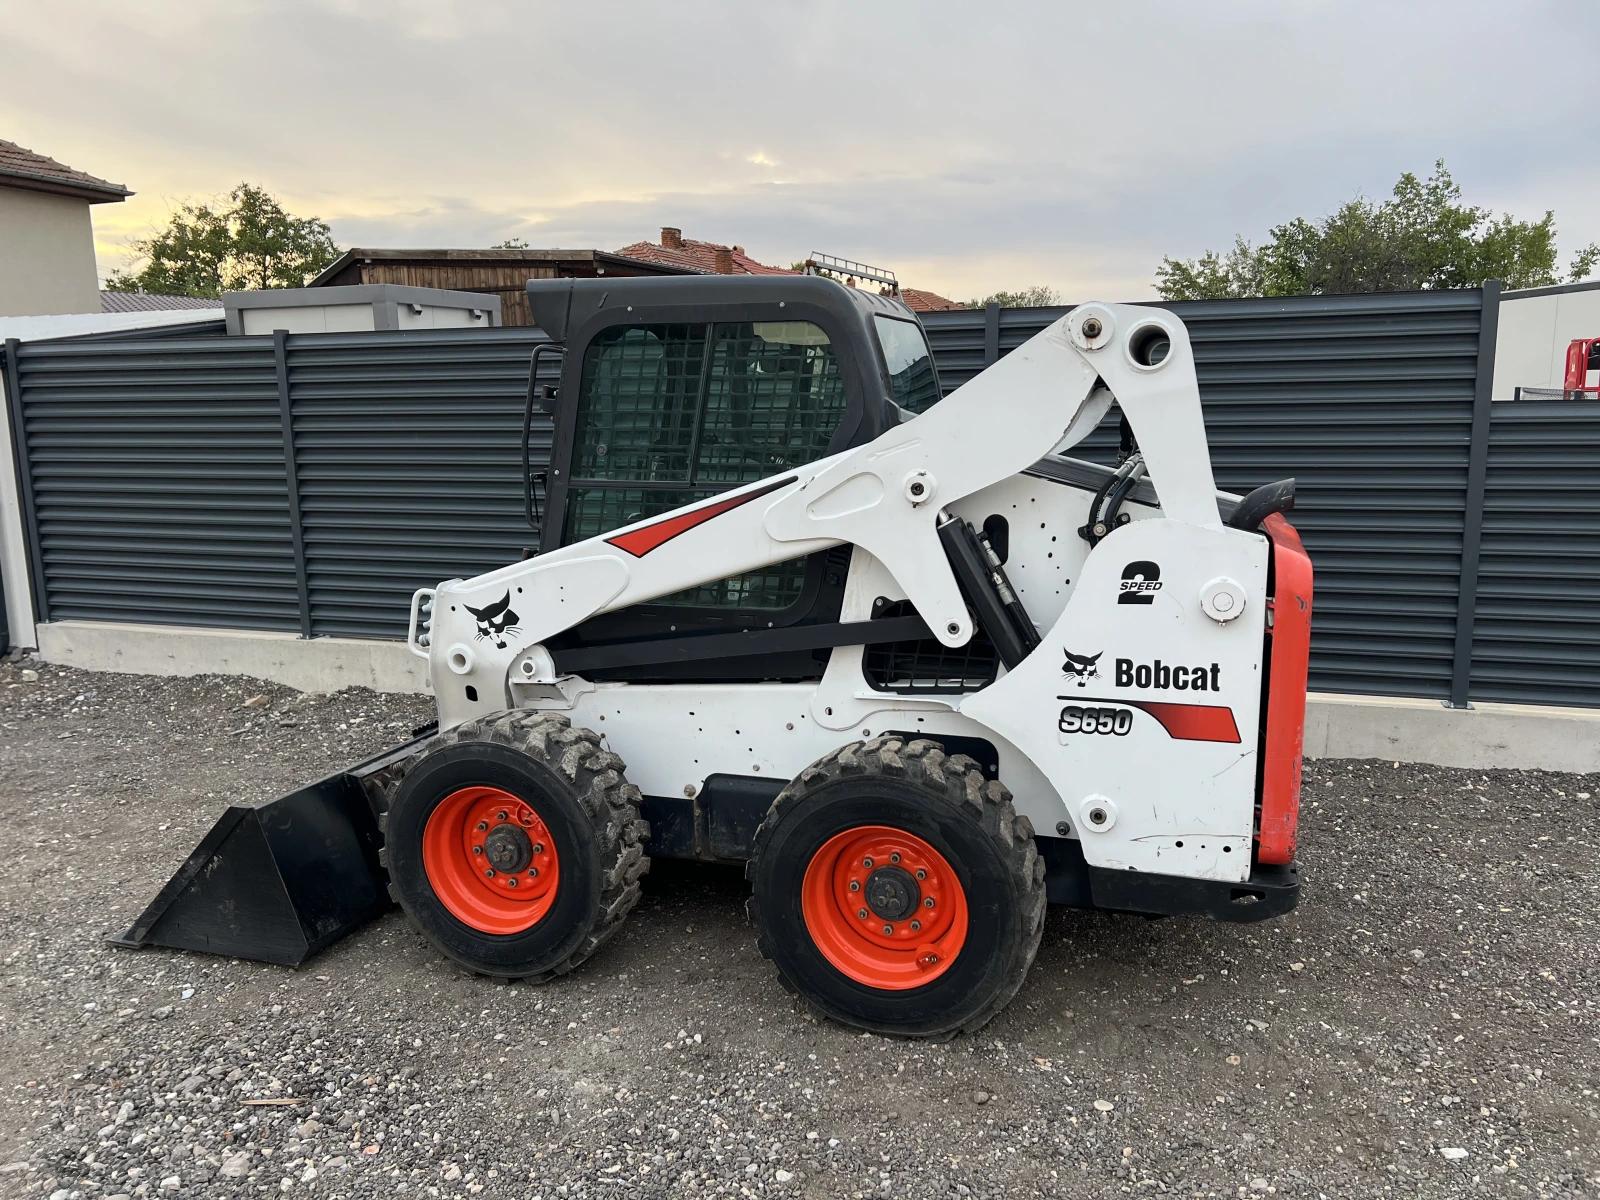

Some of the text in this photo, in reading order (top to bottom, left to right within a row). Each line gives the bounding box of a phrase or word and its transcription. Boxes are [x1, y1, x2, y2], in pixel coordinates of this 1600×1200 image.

[1117, 560, 1161, 605] 2
[1119, 581, 1163, 591] SPEED
[1115, 658, 1221, 692] Bobcat
[1058, 705, 1134, 737] S650
